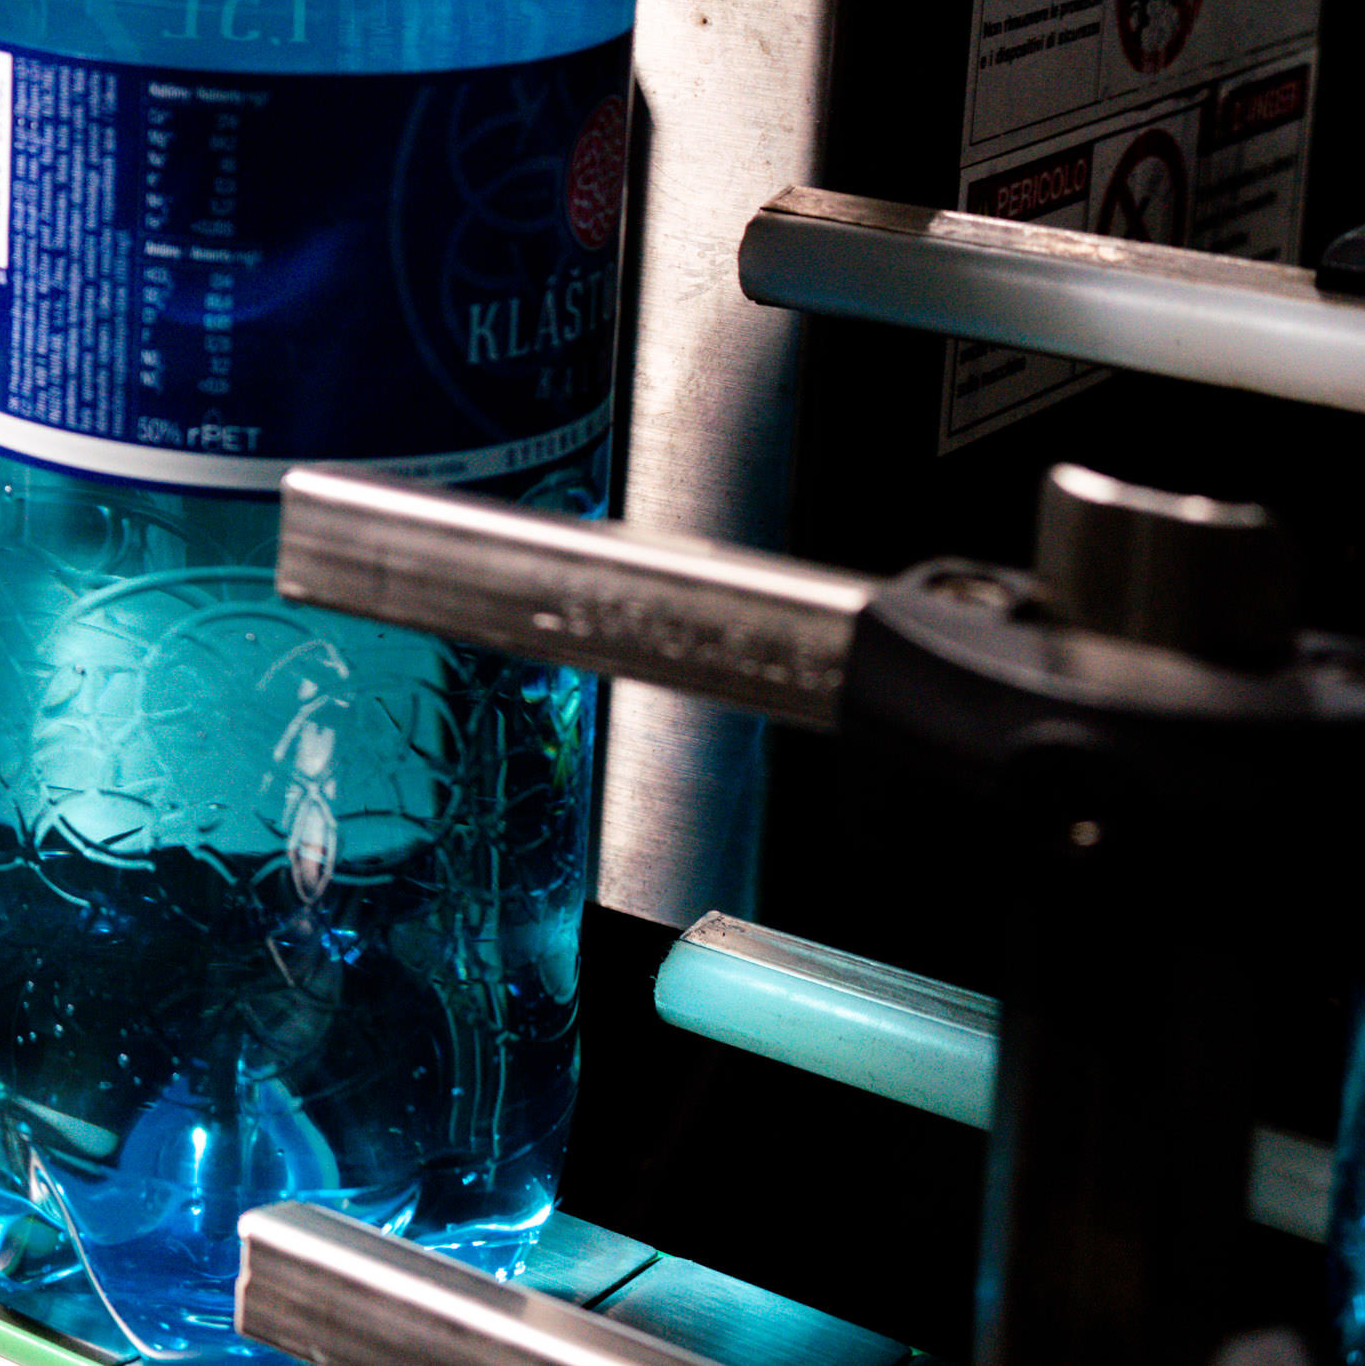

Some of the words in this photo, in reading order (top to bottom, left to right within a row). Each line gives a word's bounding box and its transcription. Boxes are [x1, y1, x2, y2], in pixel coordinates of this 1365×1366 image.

[995, 158, 1088, 219] PERICOLO
[137, 415, 183, 447] 50%
[186, 422, 262, 454] rPET
